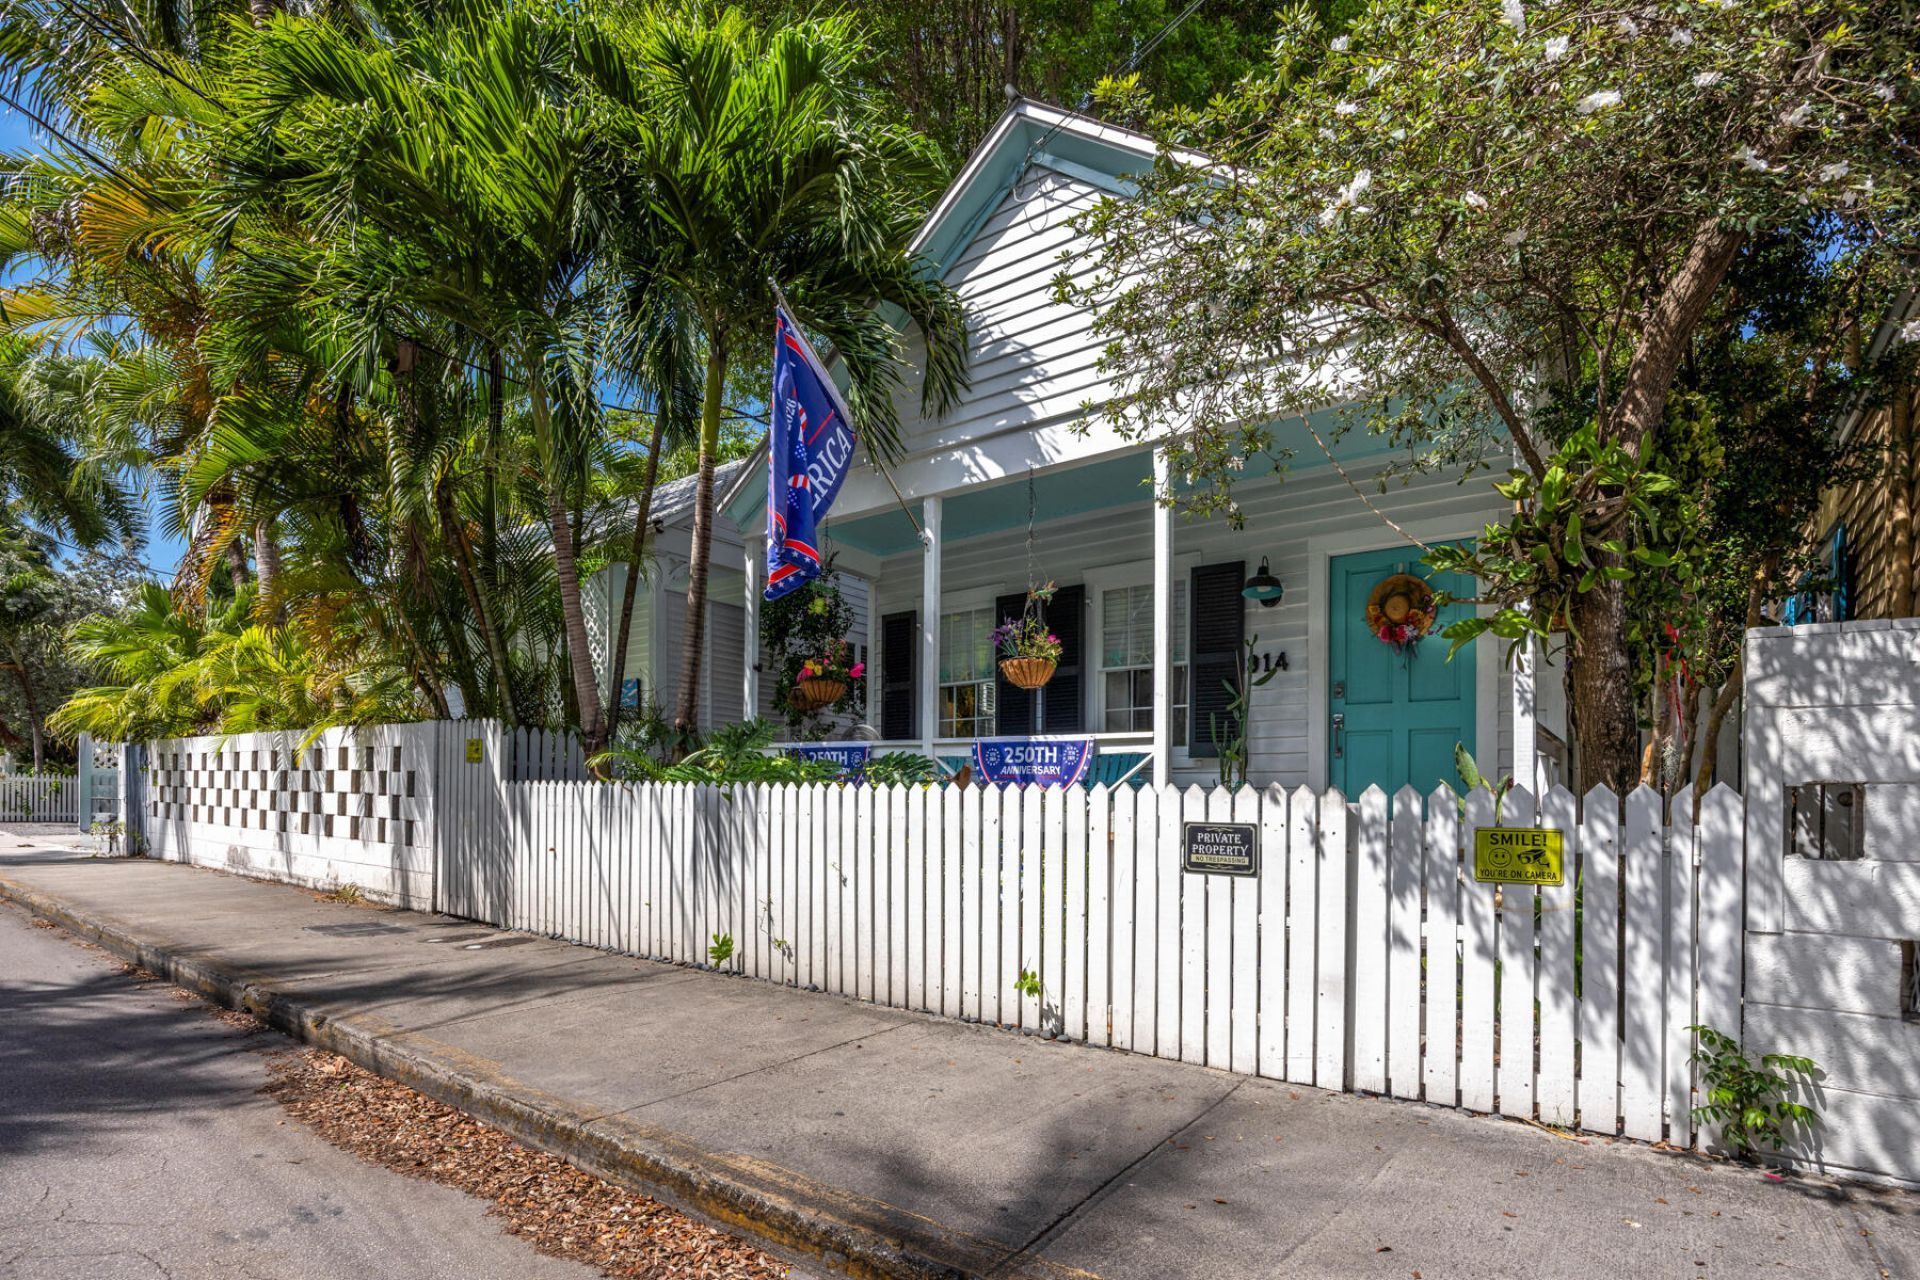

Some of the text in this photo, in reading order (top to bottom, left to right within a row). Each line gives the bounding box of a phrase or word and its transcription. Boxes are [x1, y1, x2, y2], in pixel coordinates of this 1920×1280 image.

[1004, 746, 1057, 764] 250TH
[1000, 765, 1061, 775] ANNIVERSARY
[1197, 832, 1242, 843] PRIVATE
[1489, 833, 1547, 846] SMILE!
[1192, 844, 1249, 855] PROPERTY
[1480, 869, 1557, 880] YOU'RE ON CAMERA
